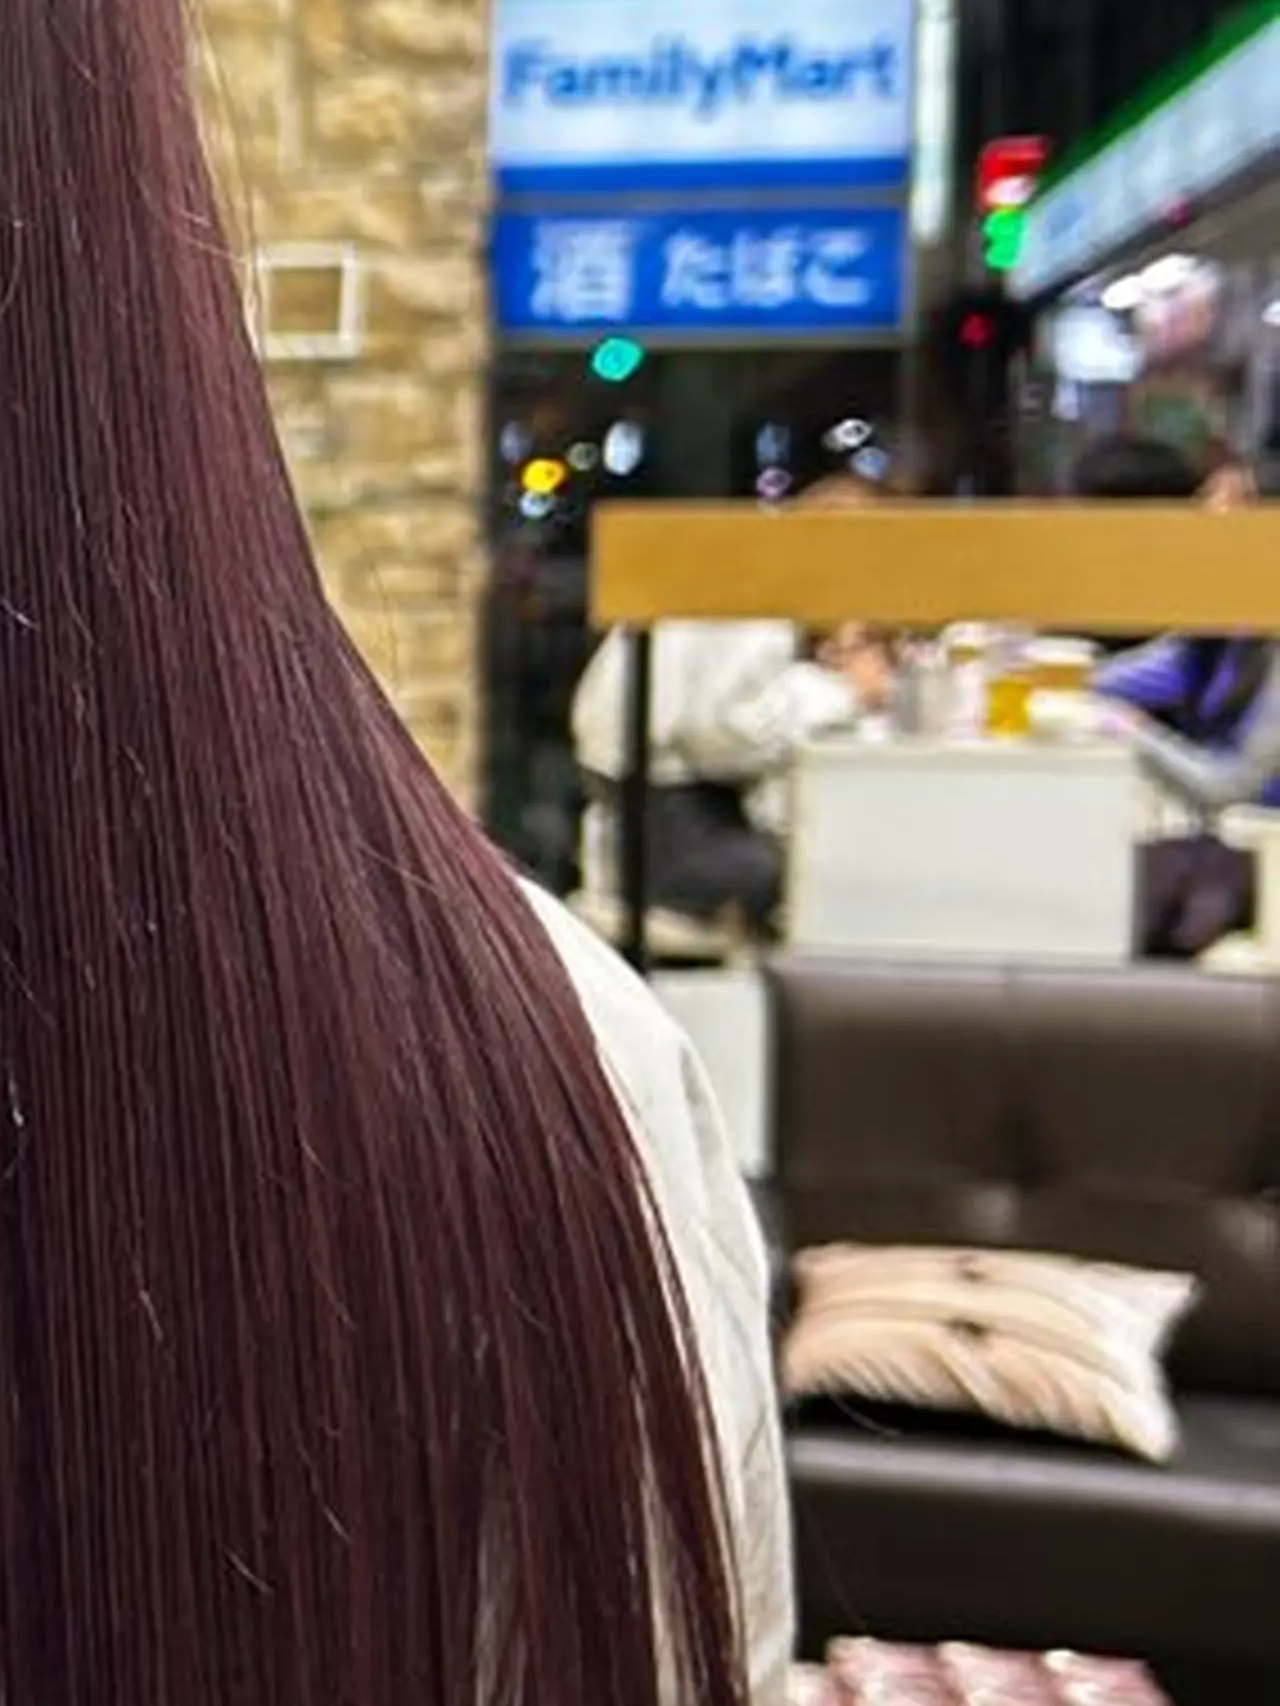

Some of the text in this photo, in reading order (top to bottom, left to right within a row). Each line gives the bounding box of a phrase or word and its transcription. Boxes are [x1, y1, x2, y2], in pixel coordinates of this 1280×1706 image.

[503, 31, 898, 123] FamilyMart
[531, 220, 872, 321] 酒 たばこ
